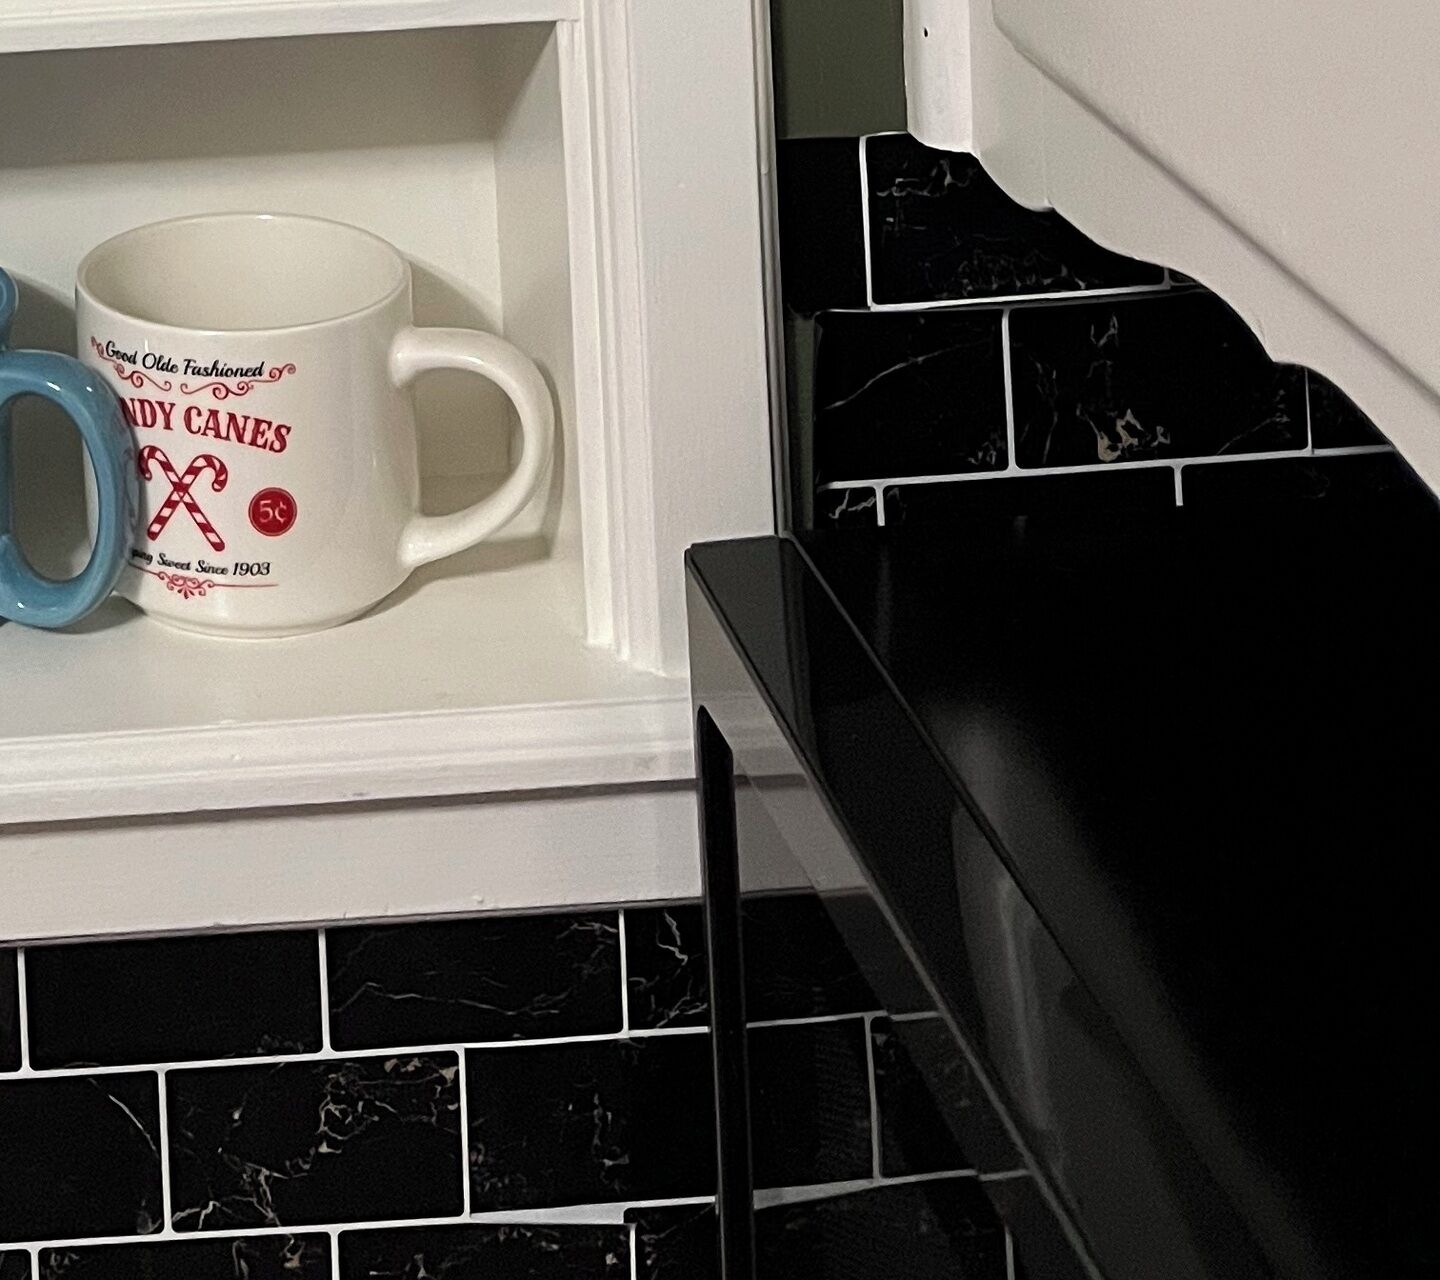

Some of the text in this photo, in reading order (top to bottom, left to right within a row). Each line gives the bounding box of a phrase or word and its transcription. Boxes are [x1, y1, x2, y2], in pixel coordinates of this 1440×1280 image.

[105, 340, 265, 378] Good Olde Fashioned
[119, 397, 292, 454] NDY CANES
[259, 500, 289, 524] 5¢
[195, 560, 228, 576] Since
[233, 560, 272, 576] 1903
